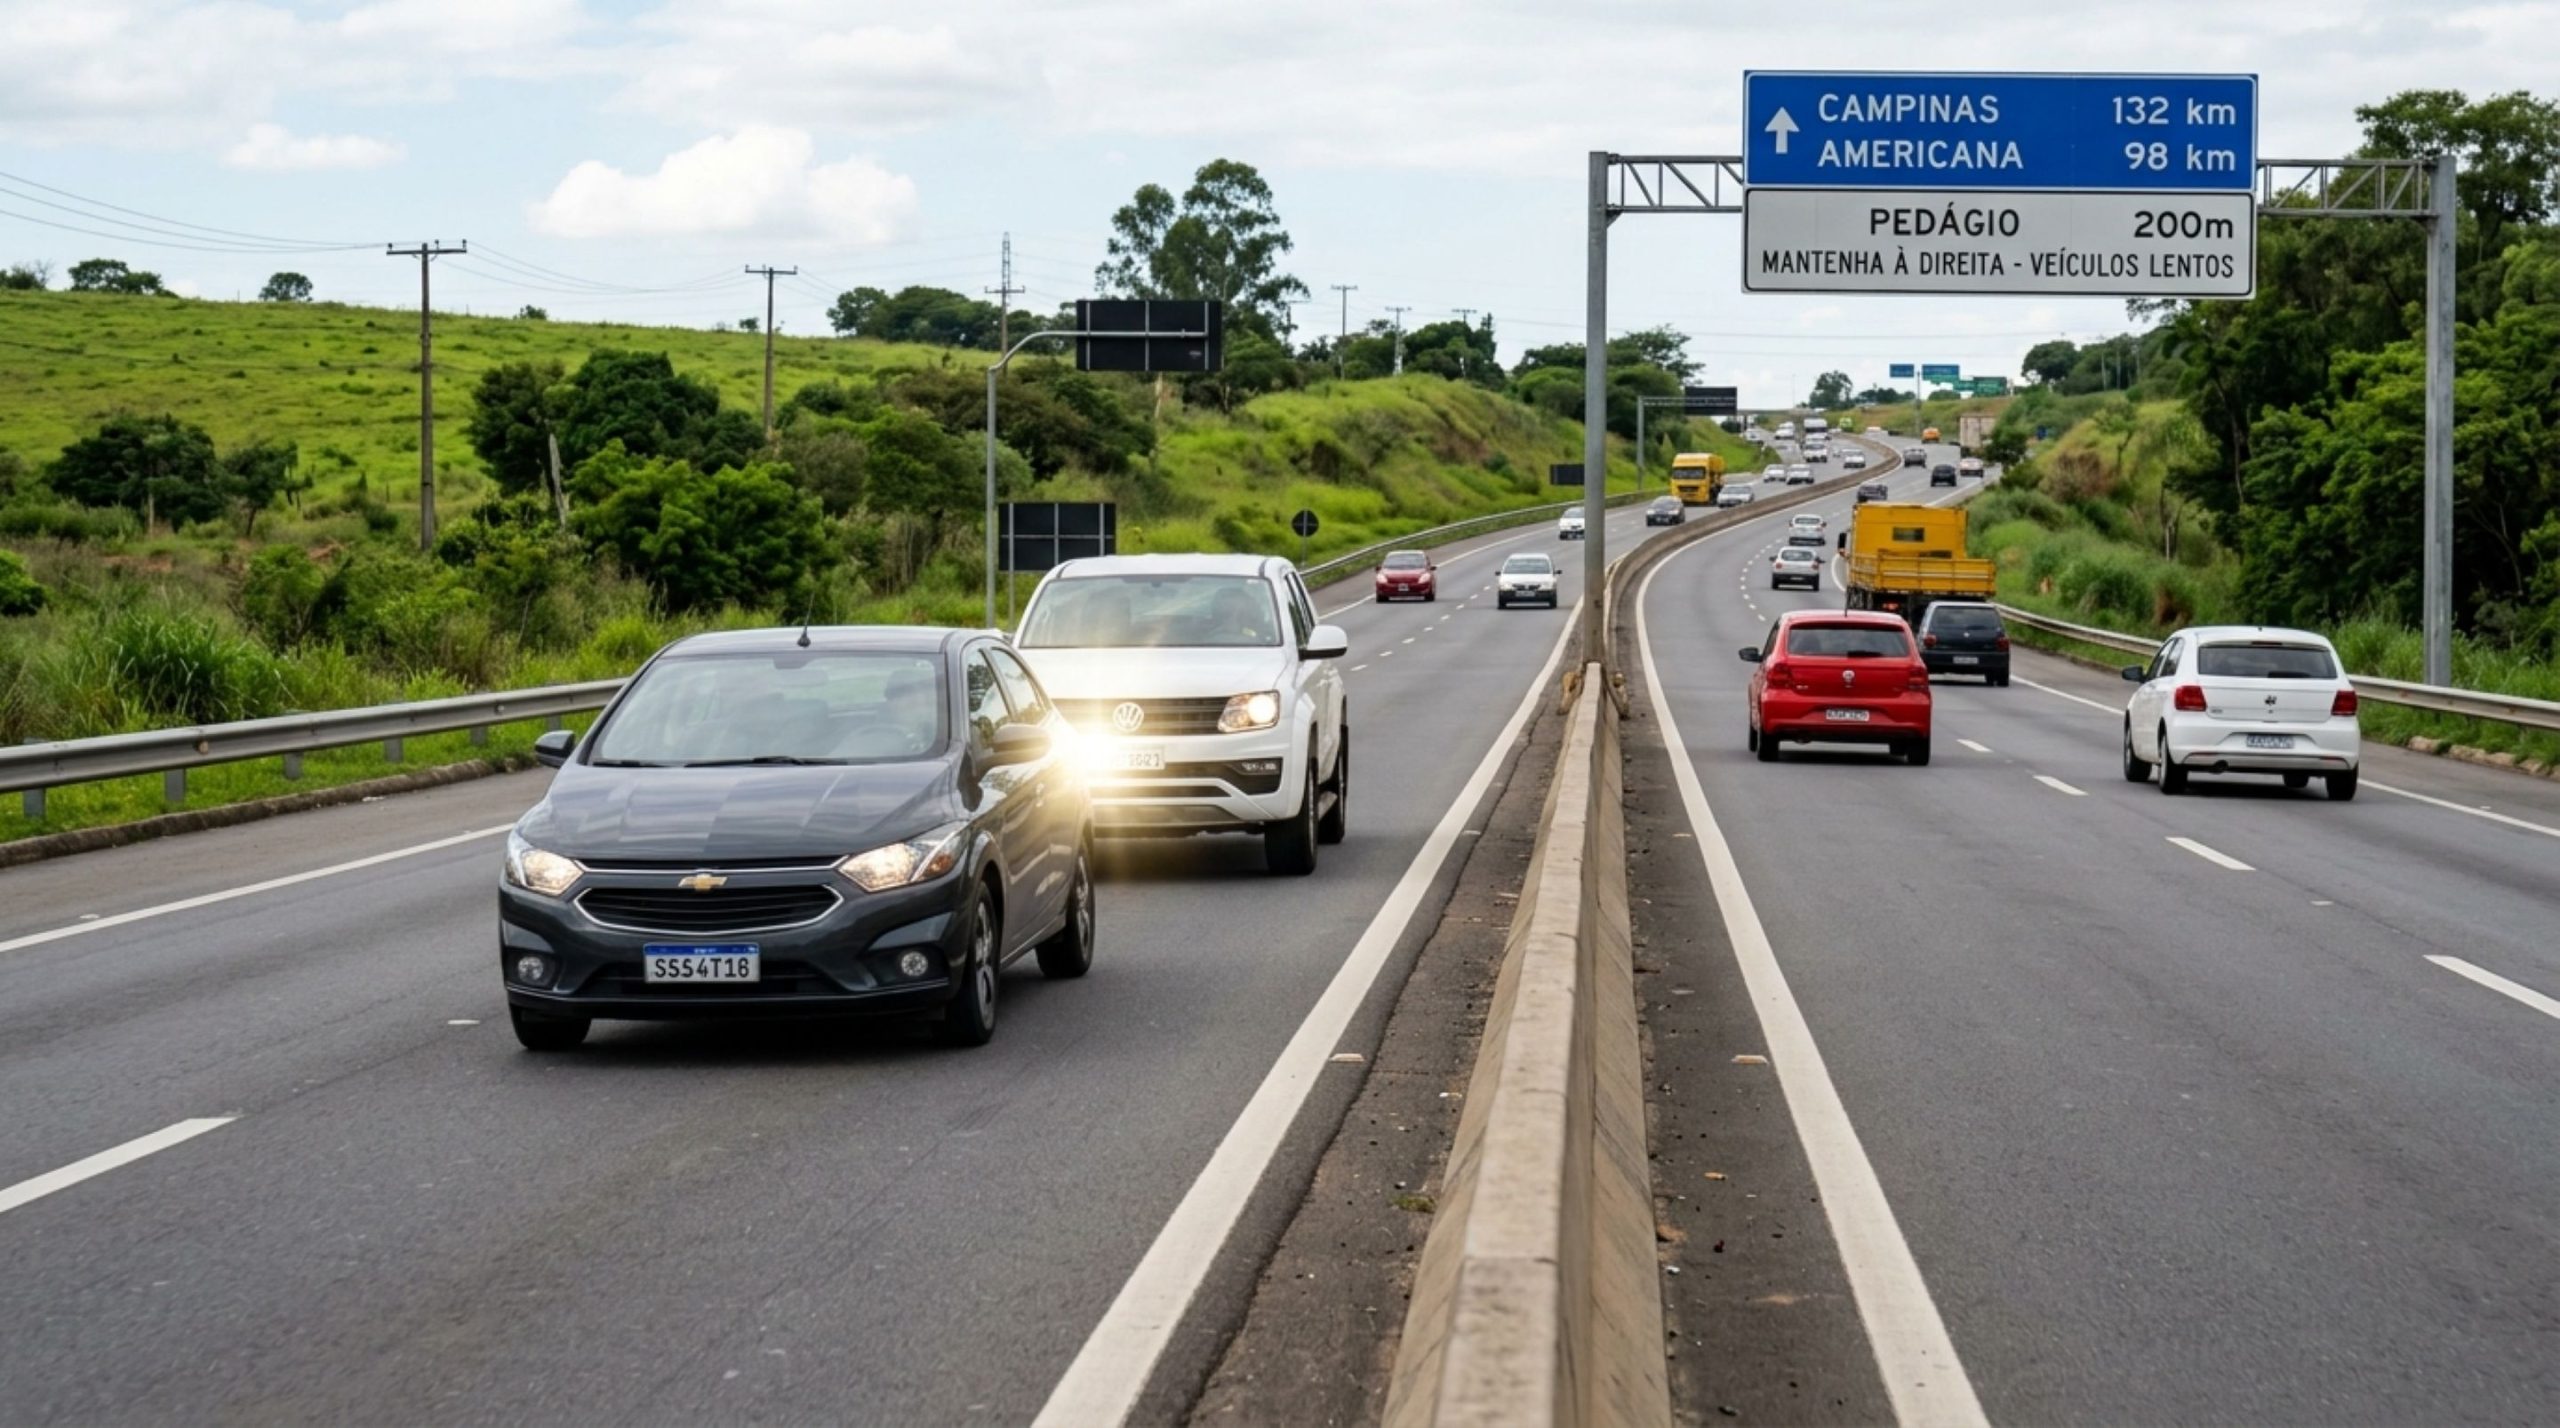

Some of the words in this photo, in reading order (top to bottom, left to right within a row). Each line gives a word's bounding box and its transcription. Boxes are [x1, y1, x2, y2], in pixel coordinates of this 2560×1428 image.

[1818, 93, 1999, 123] CAMPINAS
[2112, 96, 2169, 125] 132
[2187, 98, 2236, 125] km
[1817, 140, 2024, 169] AMERICANA
[2124, 142, 2168, 170] 98
[2187, 144, 2236, 171] km
[1869, 201, 2020, 238] PEDÁGIO
[2133, 210, 2234, 239] 200m
[1762, 249, 1884, 276] MANTENHA
[1893, 245, 1909, 276] À
[1919, 251, 2005, 277] DIREITA
[2029, 246, 2139, 278] VEÍCULOS
[2149, 253, 2234, 279] LENTOS
